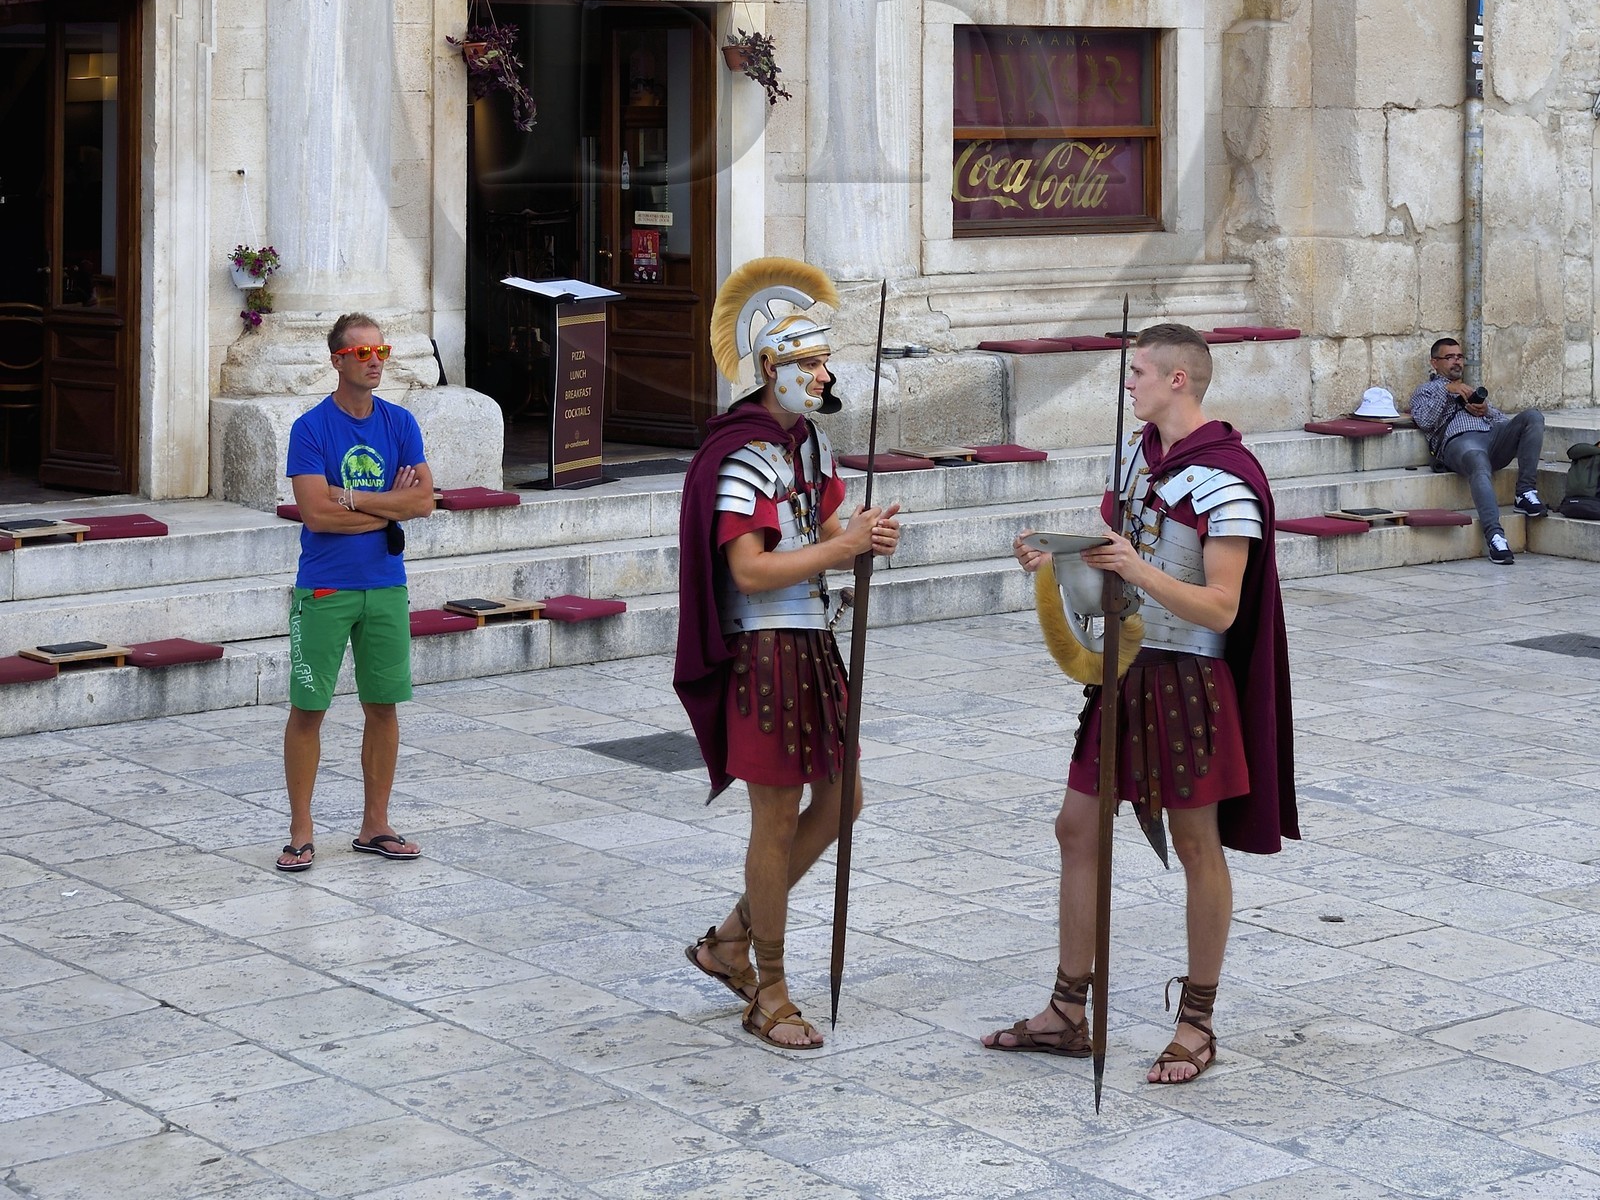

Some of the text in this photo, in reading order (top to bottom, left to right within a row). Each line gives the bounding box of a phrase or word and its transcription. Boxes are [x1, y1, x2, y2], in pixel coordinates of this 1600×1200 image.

[1006, 33, 1091, 47] KAVANA
[571, 350, 586, 362] PIZZA
[569, 368, 587, 381] LUNCH
[564, 386, 592, 401] BREAKFAST
[564, 405, 591, 420] COCKTAILS
